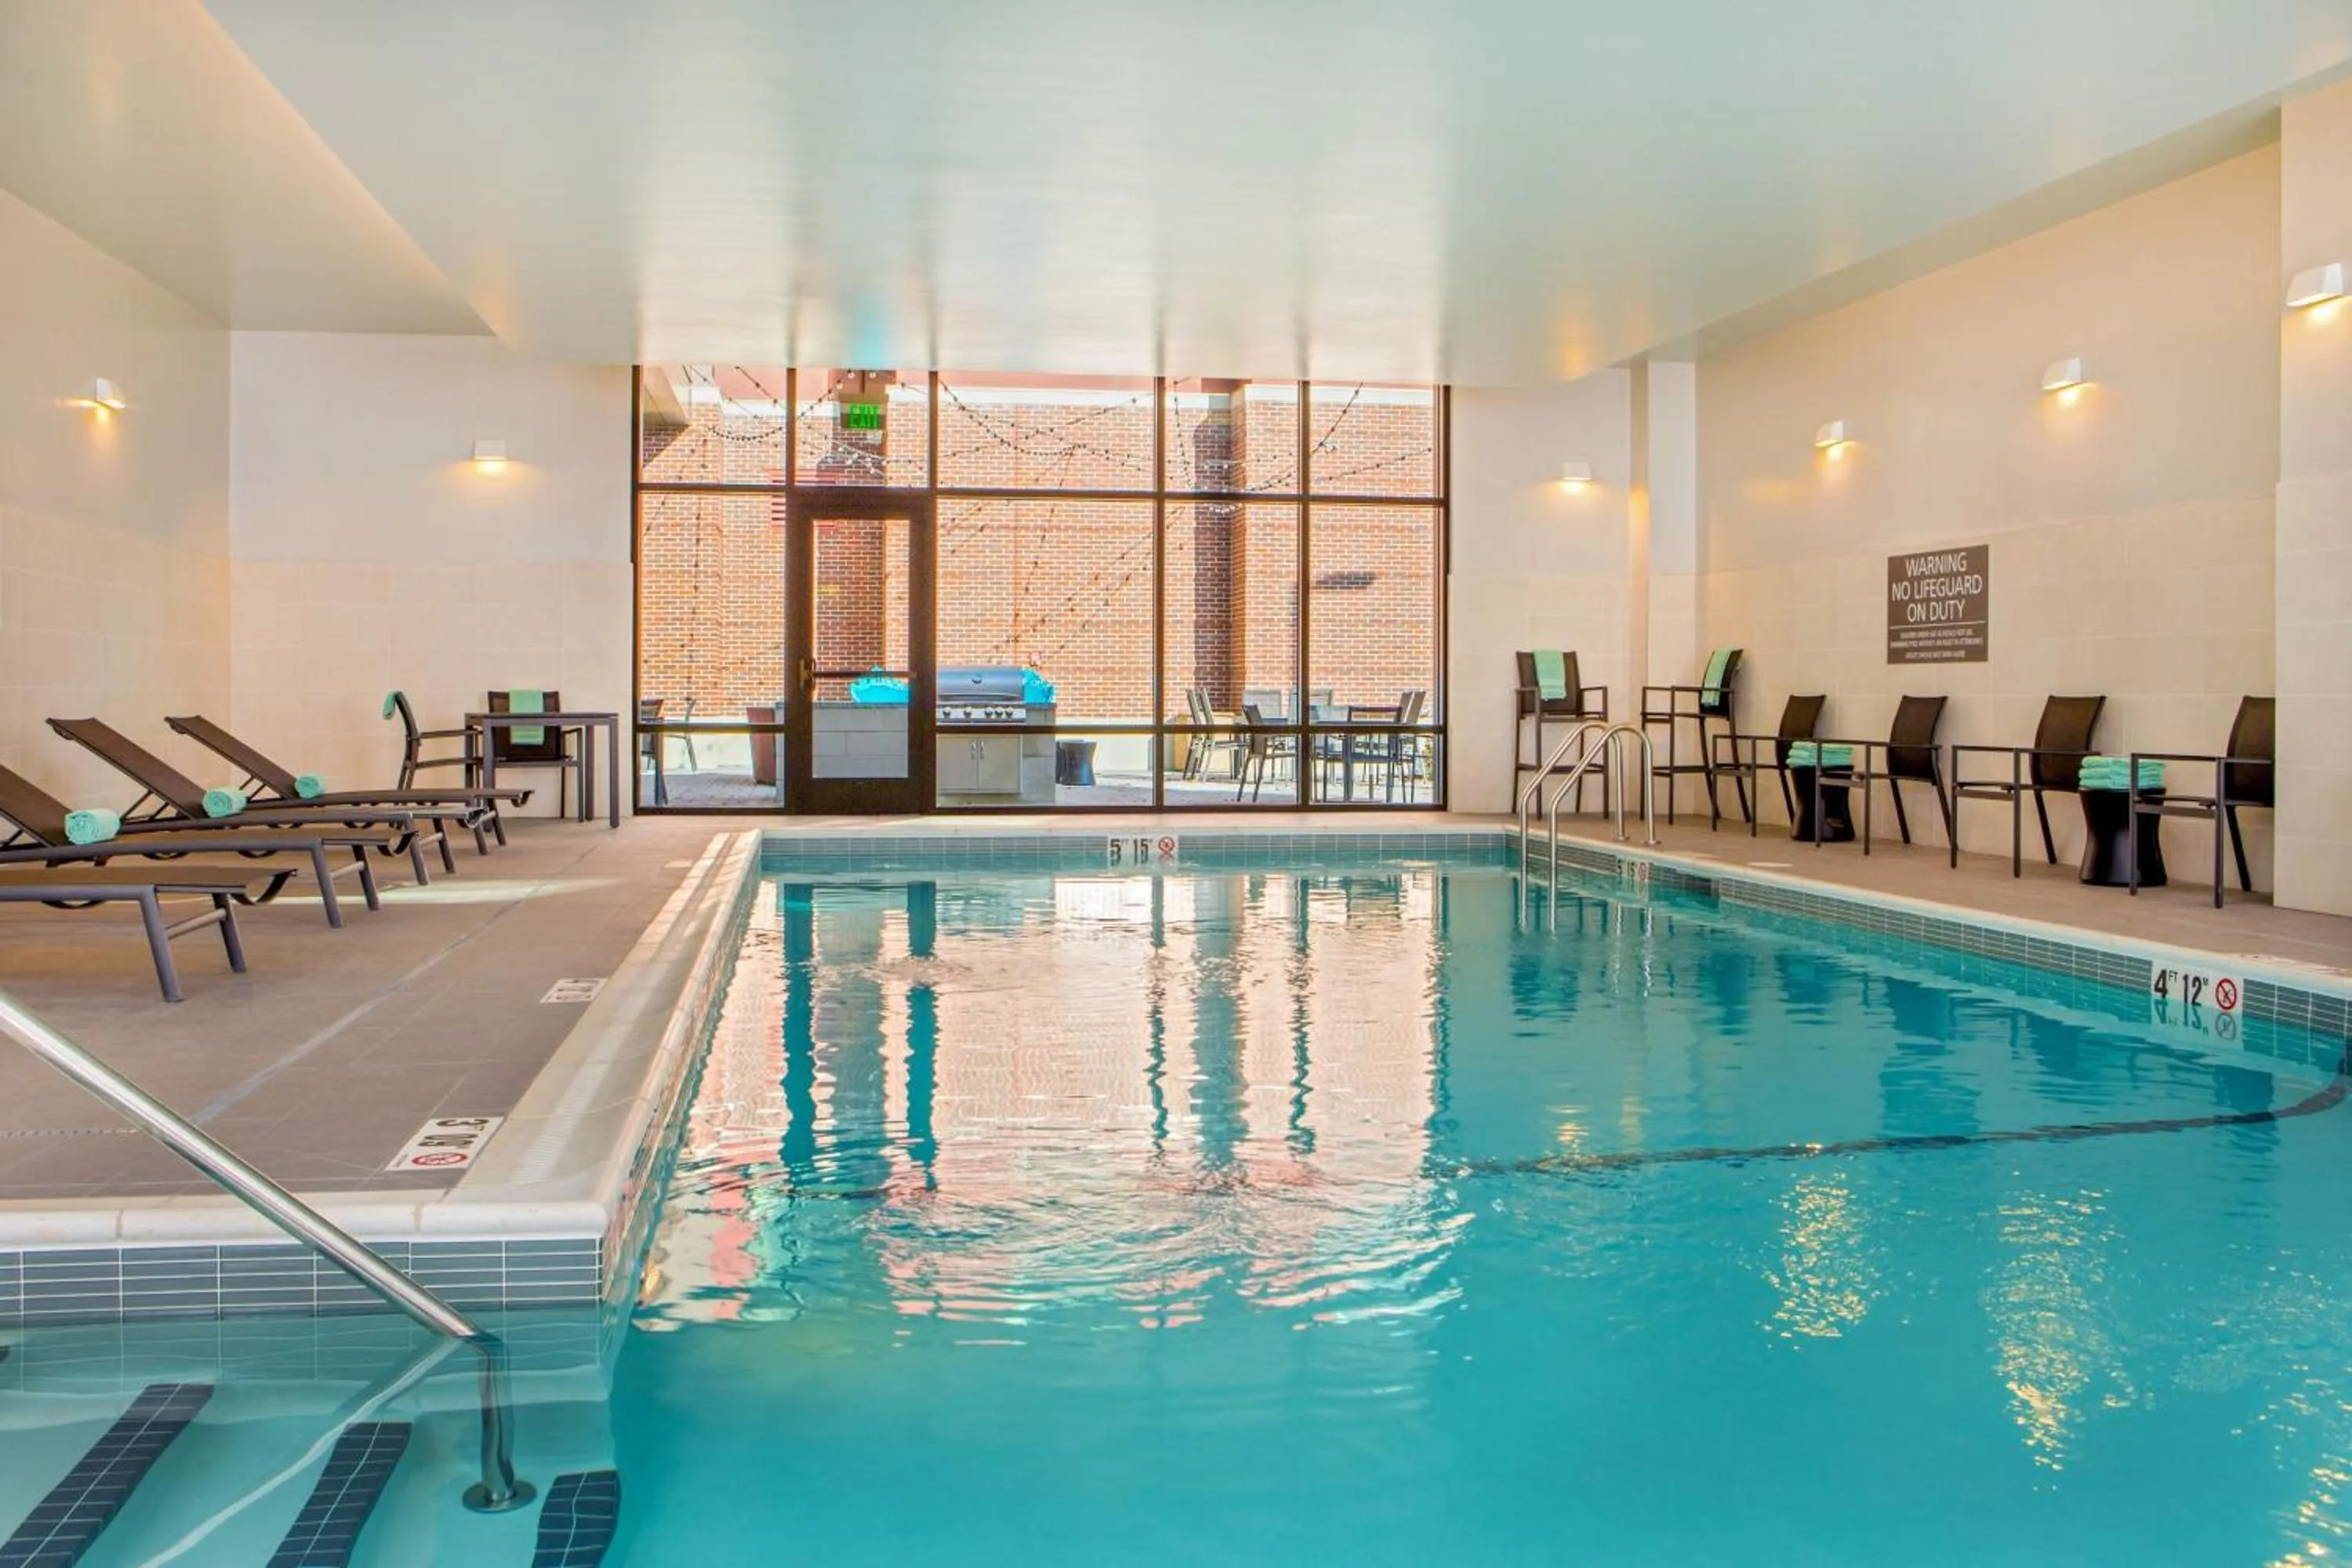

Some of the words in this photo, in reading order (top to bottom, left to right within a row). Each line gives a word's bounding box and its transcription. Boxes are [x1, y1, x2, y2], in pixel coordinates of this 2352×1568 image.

[850, 403, 879, 427] EXIT
[1906, 552, 1968, 577] WARNING
[1892, 581, 1911, 601] NO
[1914, 575, 1983, 600] LIFEGUARD
[1907, 603, 1926, 622] ON
[1929, 599, 1966, 621] DUTY
